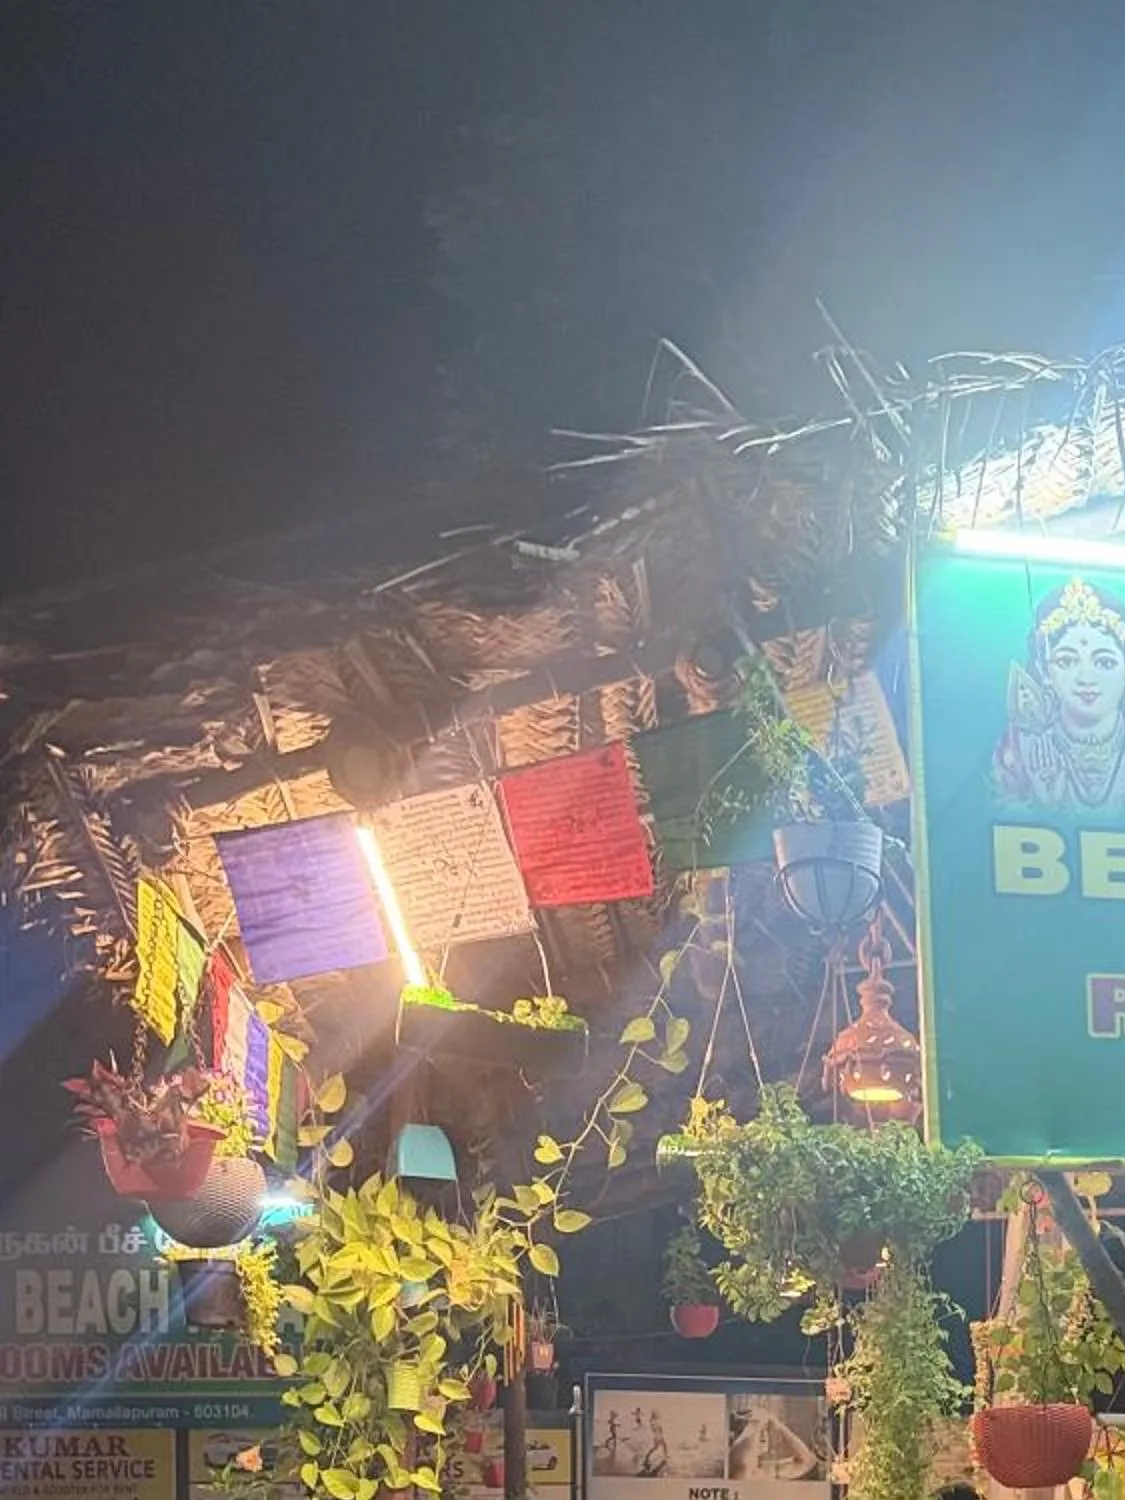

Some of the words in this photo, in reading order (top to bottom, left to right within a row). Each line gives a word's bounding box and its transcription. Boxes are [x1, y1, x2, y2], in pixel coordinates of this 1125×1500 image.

[15, 1269, 170, 1335] BEACH
[0, 1343, 109, 1381] OOMS
[4, 1436, 130, 1457] KUMAR
[1, 1461, 65, 1480] ENTAL
[72, 1460, 156, 1480] SERVICE
